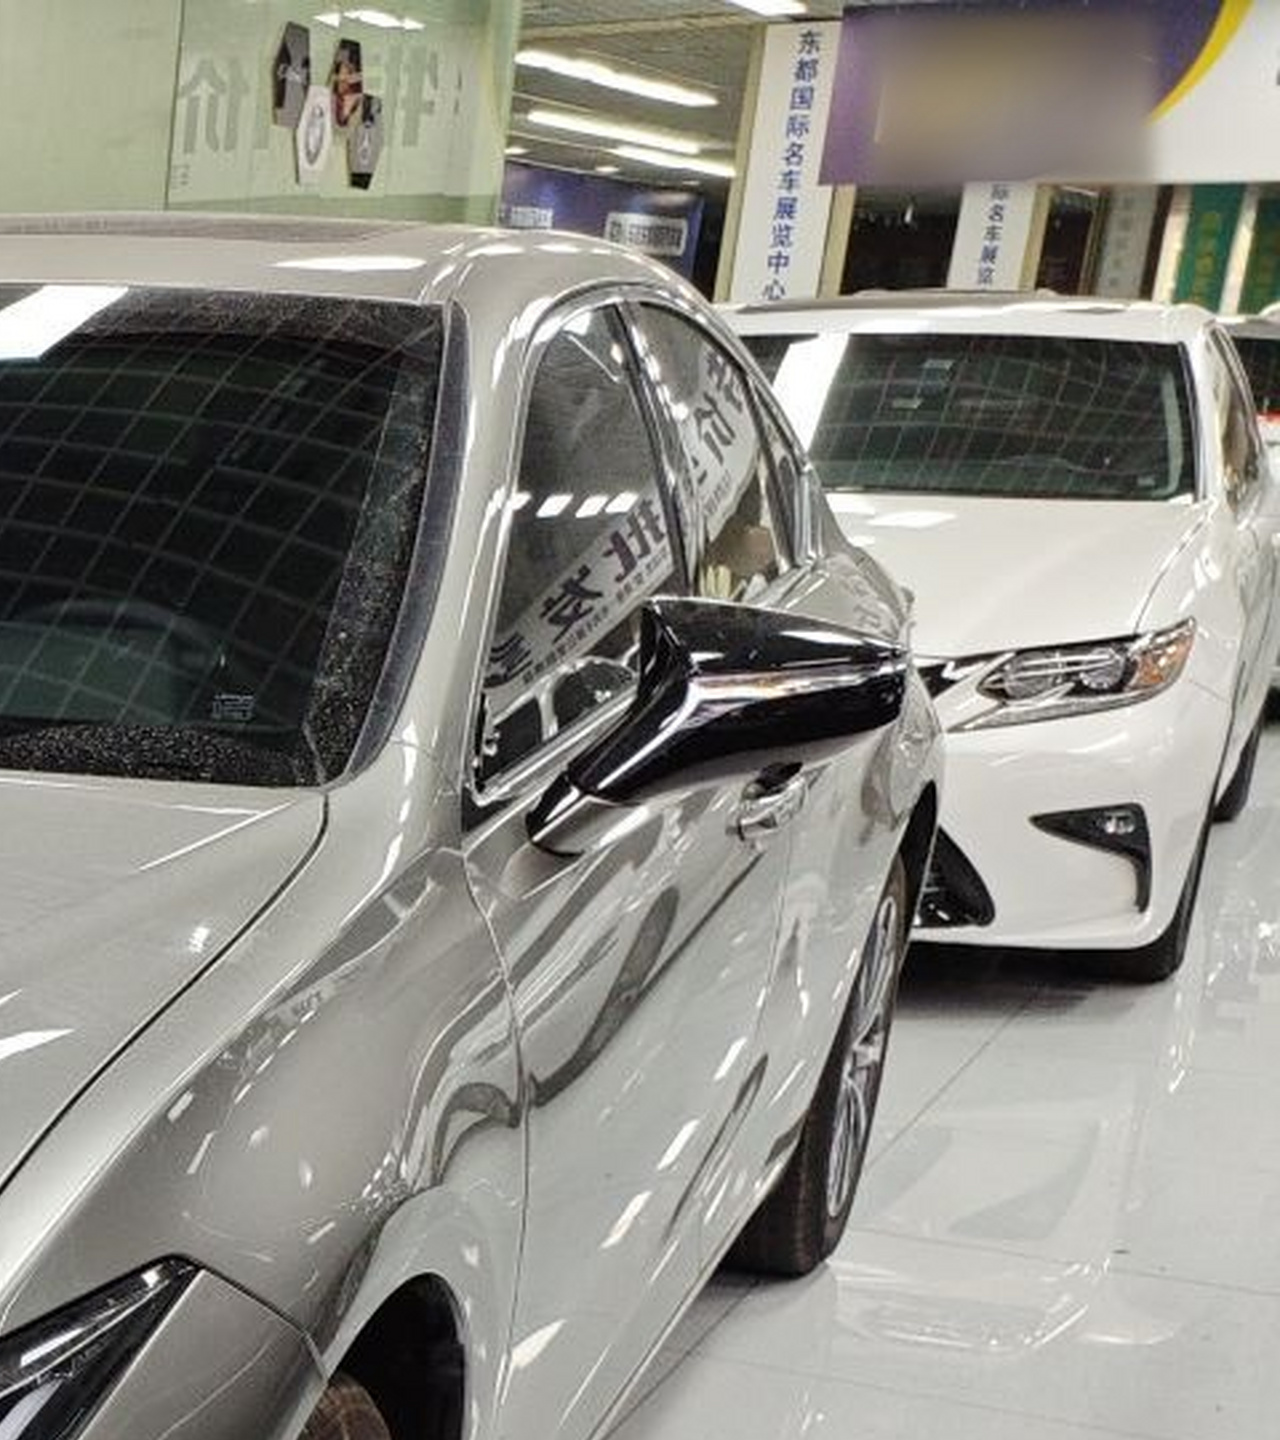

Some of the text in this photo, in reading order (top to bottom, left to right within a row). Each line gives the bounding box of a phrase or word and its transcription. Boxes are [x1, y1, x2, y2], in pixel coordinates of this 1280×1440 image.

[762, 29, 822, 301] 东都国际名车展览中心
